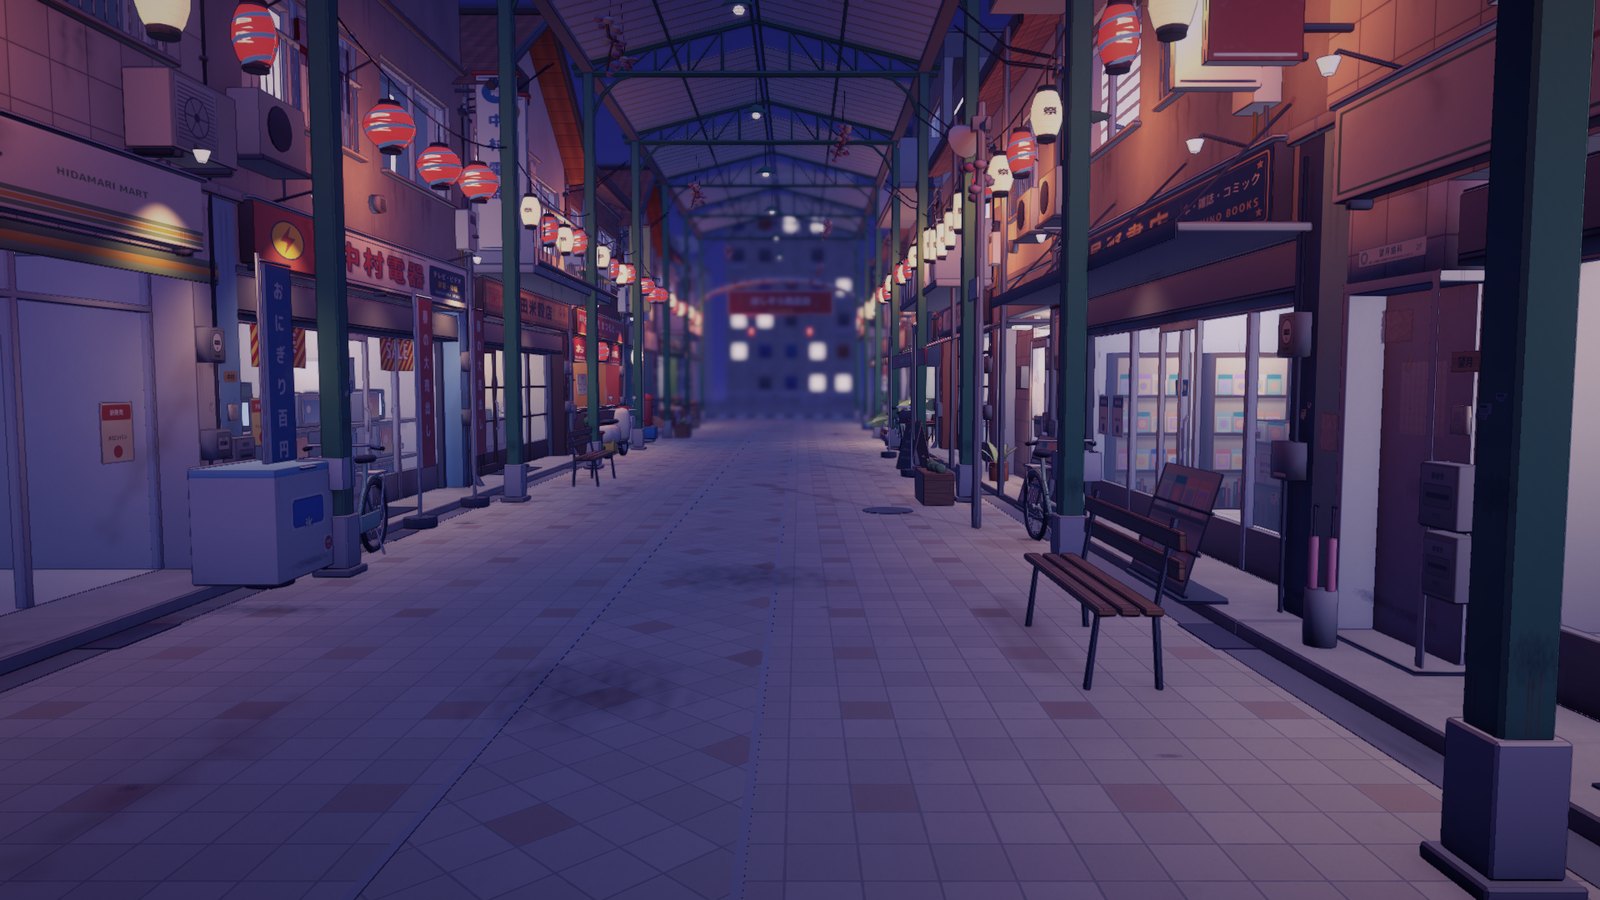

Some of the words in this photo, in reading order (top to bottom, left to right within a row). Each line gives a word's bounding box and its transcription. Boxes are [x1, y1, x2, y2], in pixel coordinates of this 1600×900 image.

[56, 166, 116, 190] HIDAMARI
[119, 183, 149, 200] MART
[1225, 196, 1260, 218] BOOKS
[345, 240, 425, 290] 中村電器
